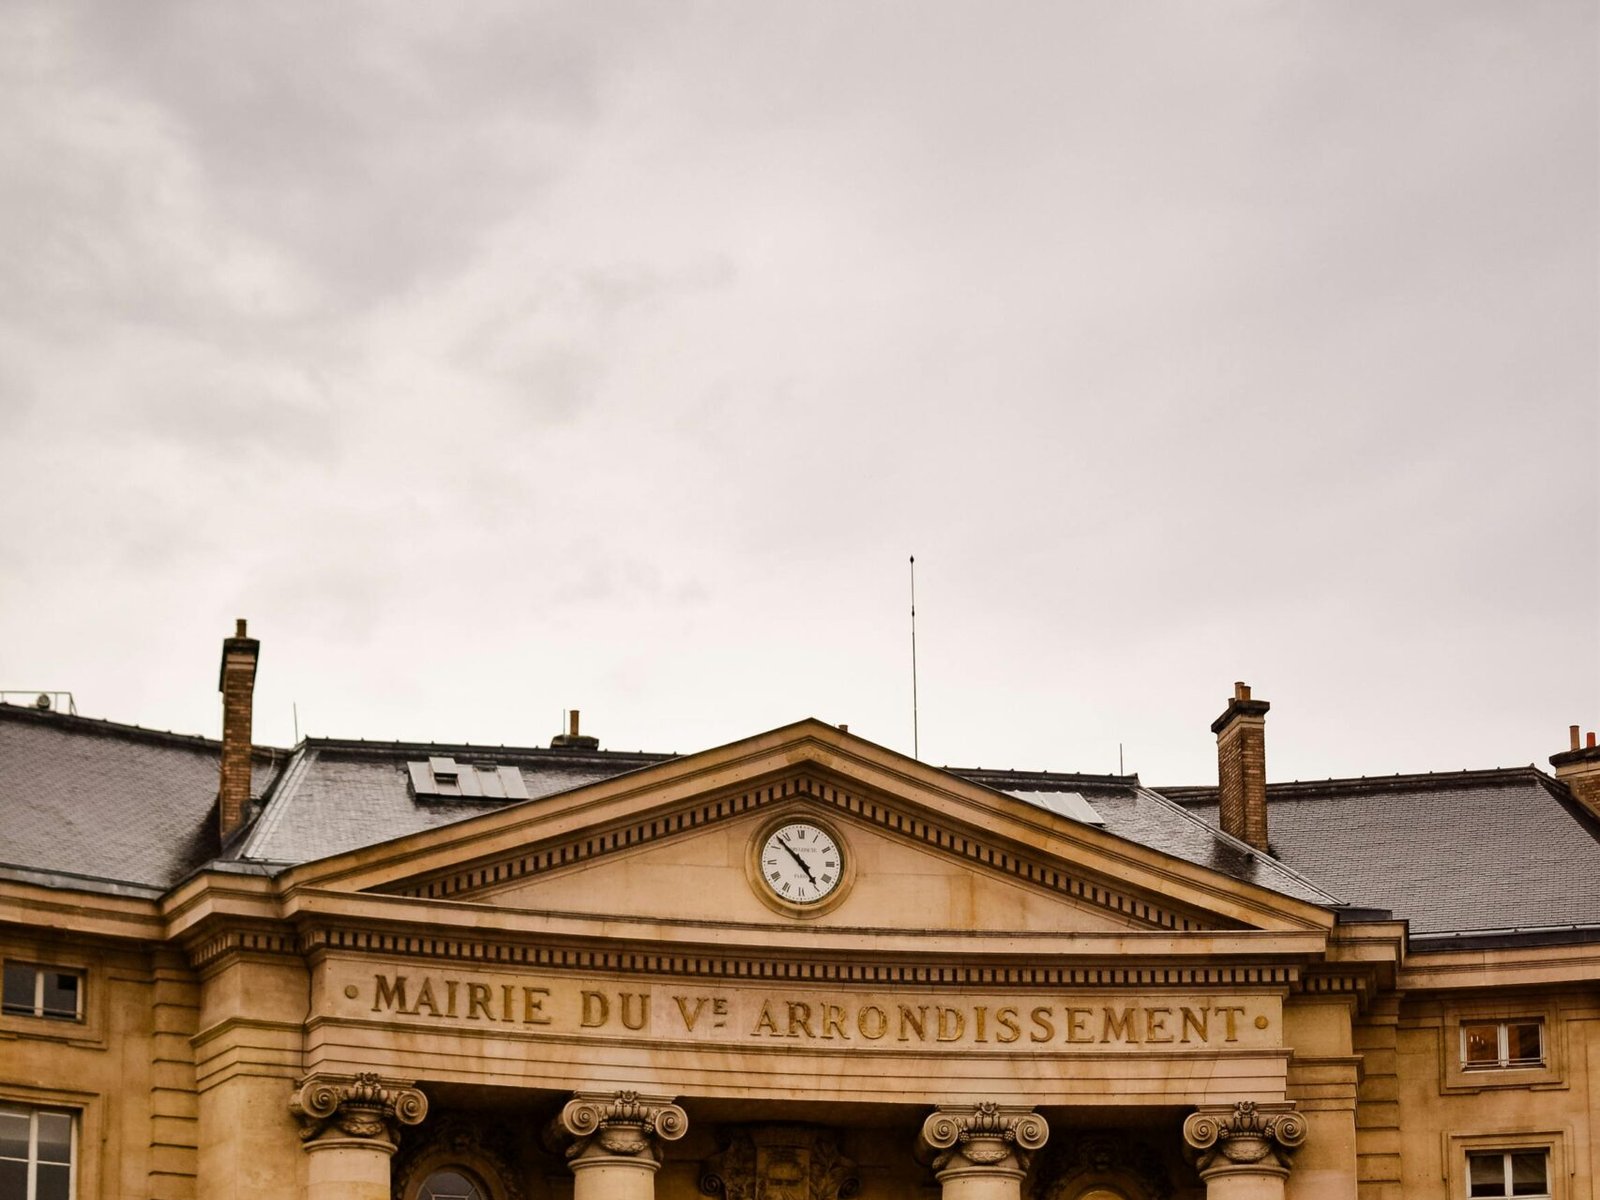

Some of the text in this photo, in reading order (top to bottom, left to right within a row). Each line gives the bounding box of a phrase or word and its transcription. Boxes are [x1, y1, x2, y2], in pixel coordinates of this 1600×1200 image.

[371, 974, 551, 1026] MAIRIE
[580, 990, 651, 1031] DU
[750, 1000, 1246, 1044] ARRONDISSEMENT
